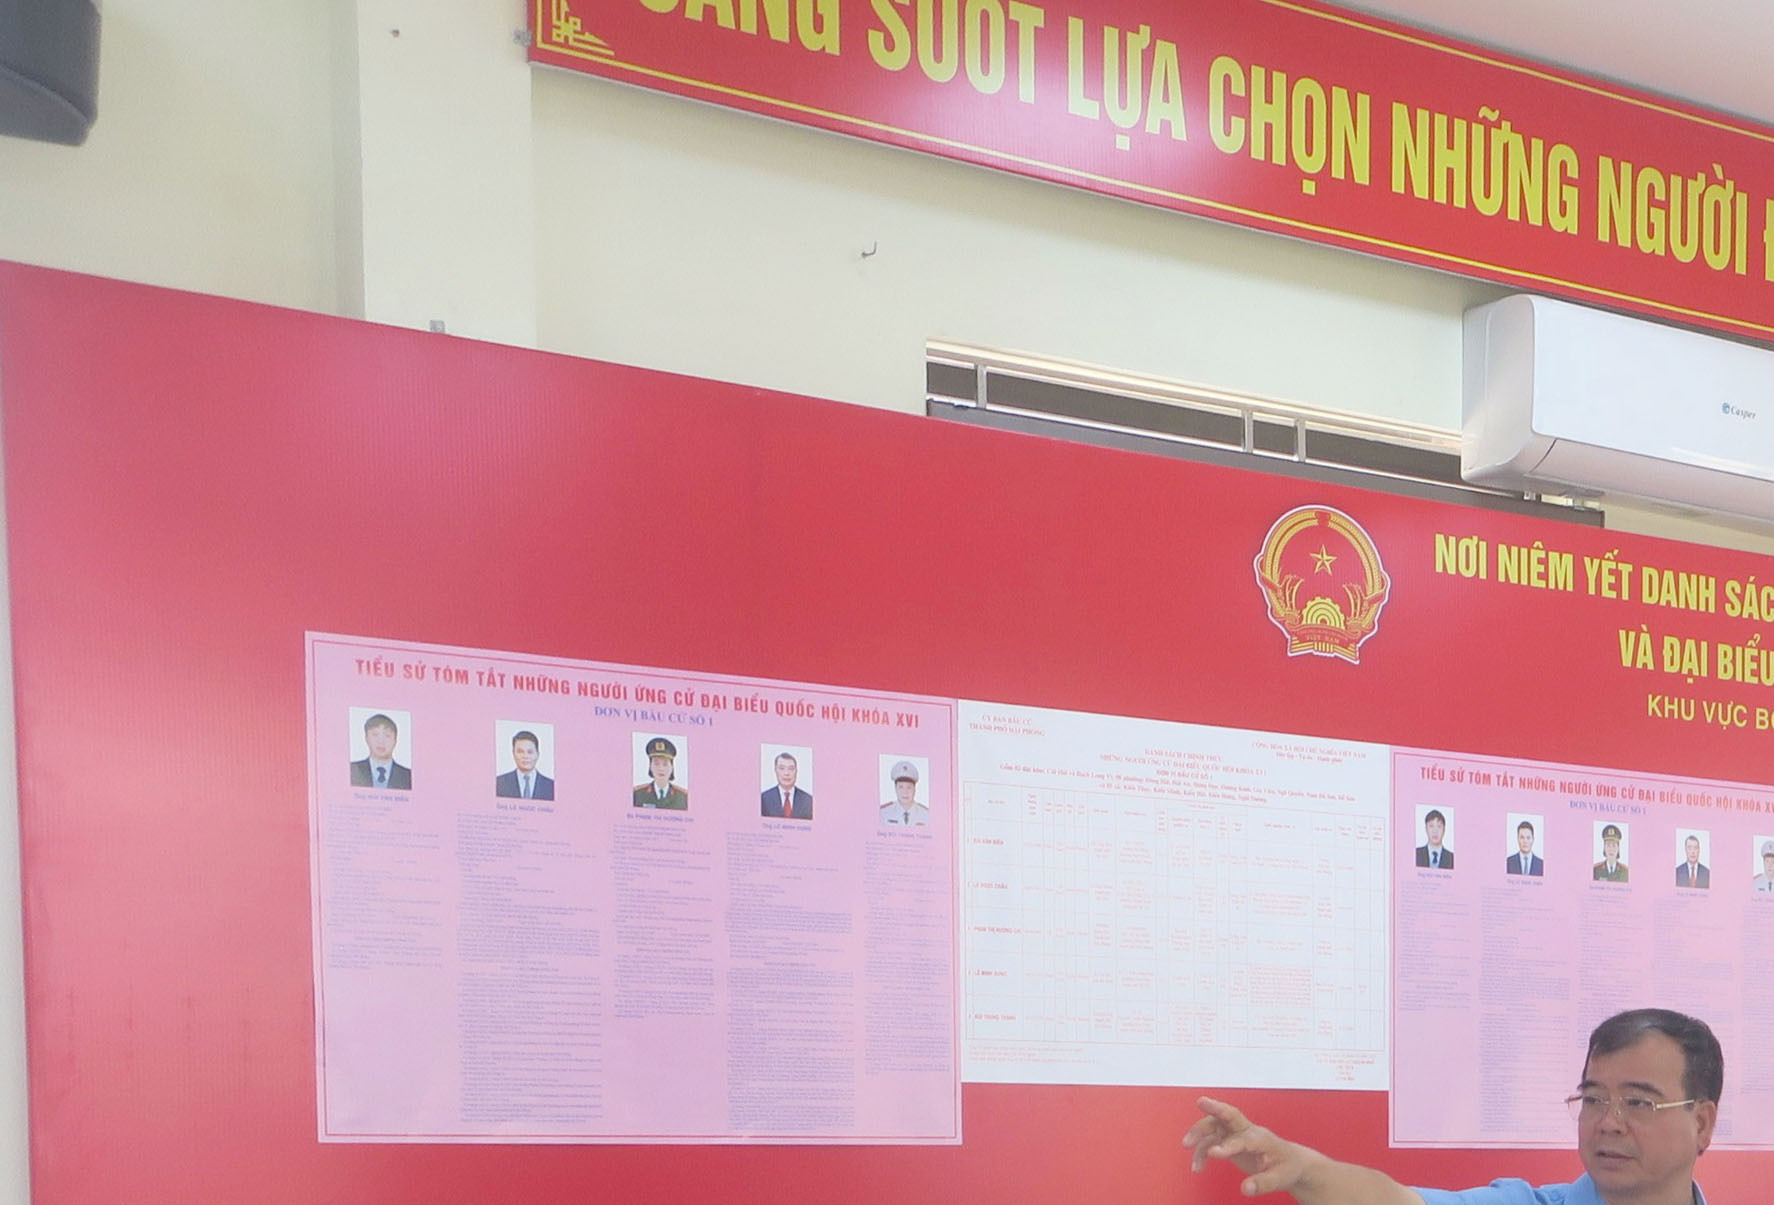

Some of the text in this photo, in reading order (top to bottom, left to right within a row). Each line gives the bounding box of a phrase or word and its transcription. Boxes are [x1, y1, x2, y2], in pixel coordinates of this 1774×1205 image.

[1068, 17, 1187, 150] LỰA
[1209, 55, 1370, 195] CHỌN
[1392, 107, 1579, 235] NHỮNG
[1598, 164, 1747, 275] NGƯỜI
[1434, 533, 1488, 579] NƠI
[1497, 541, 1573, 592] NIÊM
[1583, 548, 1632, 600] YẾT
[1642, 567, 1716, 613] DANH
[1618, 629, 1655, 671] VÀ
[1663, 639, 1708, 684] ĐẠI
[355, 654, 919, 728] TIỂU SỬ TÓM TẮT NHỮNG NGƯỜI ỨNG CỬ ĐẠI BIỂU QUỐC HỘI KHÓA XVI
[1647, 694, 1695, 721] KHU
[1703, 699, 1747, 732] VỰC
[1421, 764, 1445, 781] TIỂU
[1450, 767, 1465, 783] SỬ
[1469, 771, 1491, 785] TÓM
[1496, 771, 1514, 788] TẮT
[1519, 775, 1555, 792] NHỮNG
[1560, 778, 1592, 796] NGƯỜI
[1596, 781, 1617, 798] ỨNG
[1621, 784, 1636, 800] CỬ
[1638, 788, 1656, 804] ĐẠI
[1659, 788, 1683, 805] BIỂU
[1686, 790, 1712, 807] QUỐC
[1716, 794, 1733, 811] HỘI
[1736, 796, 1762, 813] KHÓA
